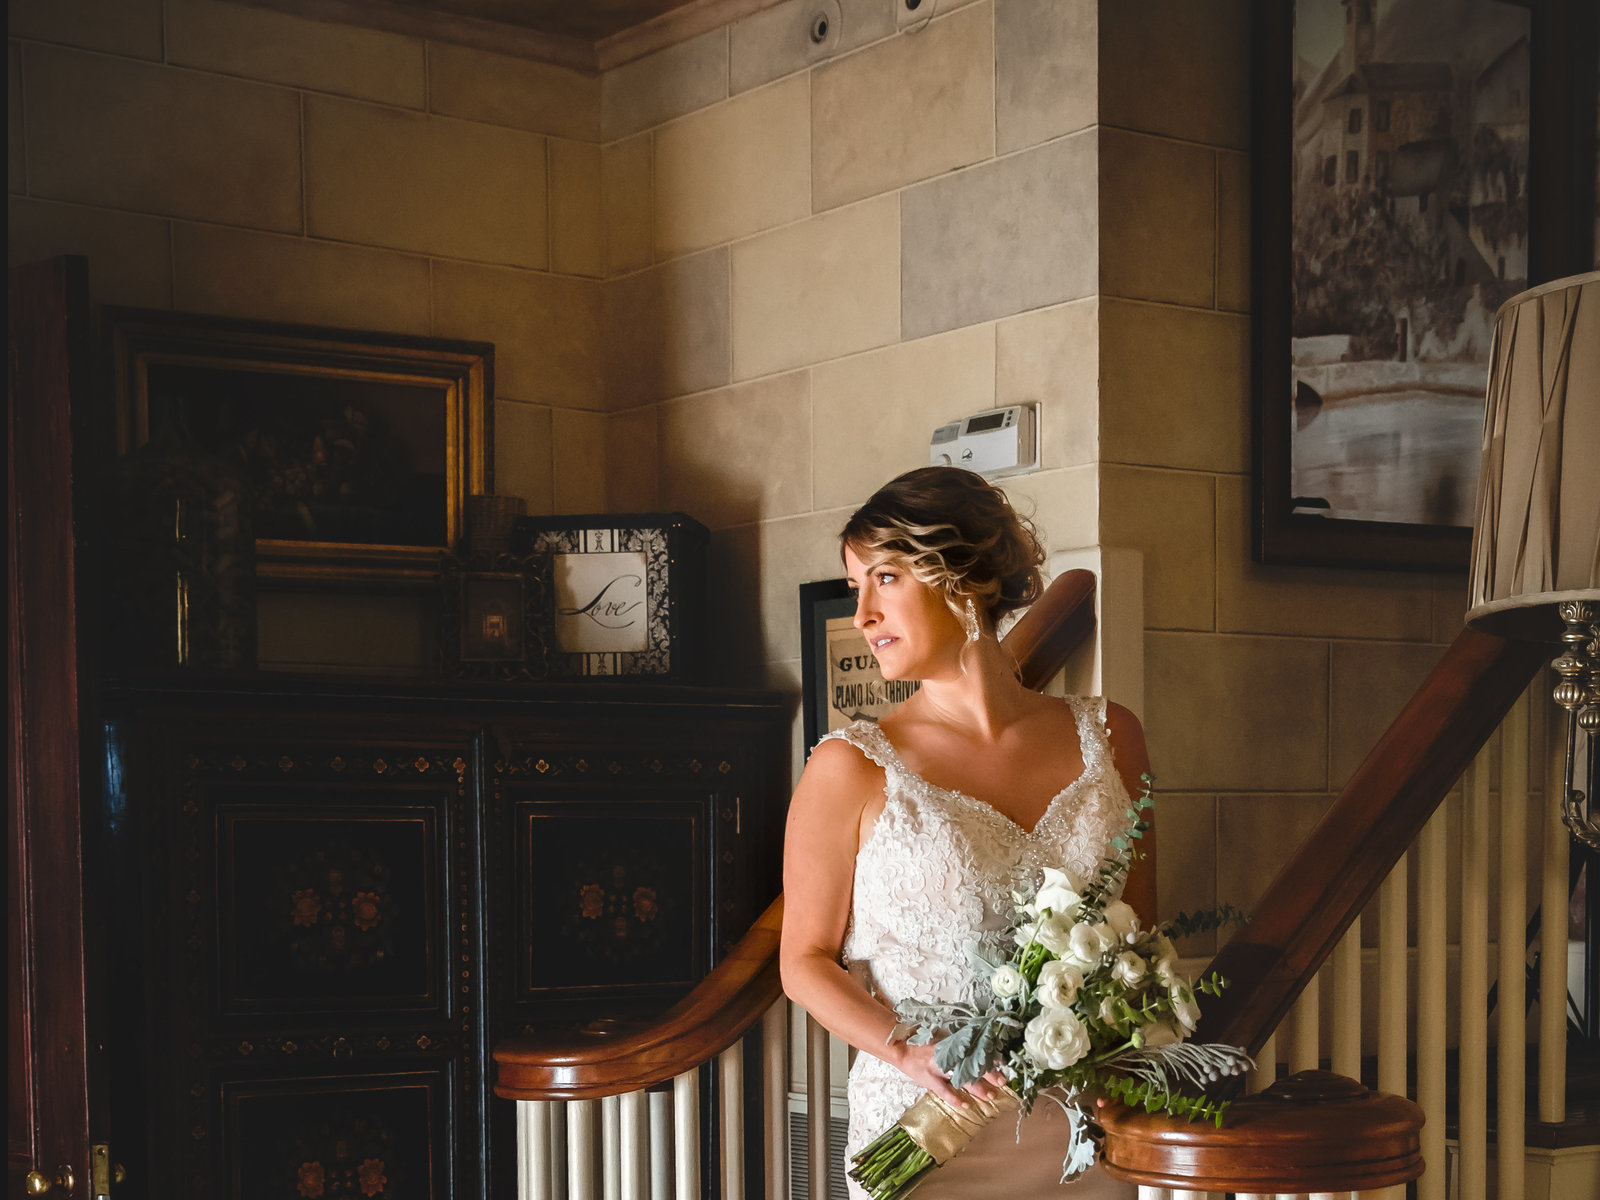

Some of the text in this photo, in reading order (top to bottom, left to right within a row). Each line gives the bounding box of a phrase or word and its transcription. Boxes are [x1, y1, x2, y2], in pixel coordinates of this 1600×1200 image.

[558, 574, 643, 629] Love
[836, 683, 863, 708] PLANO
[866, 682, 875, 706] IS
